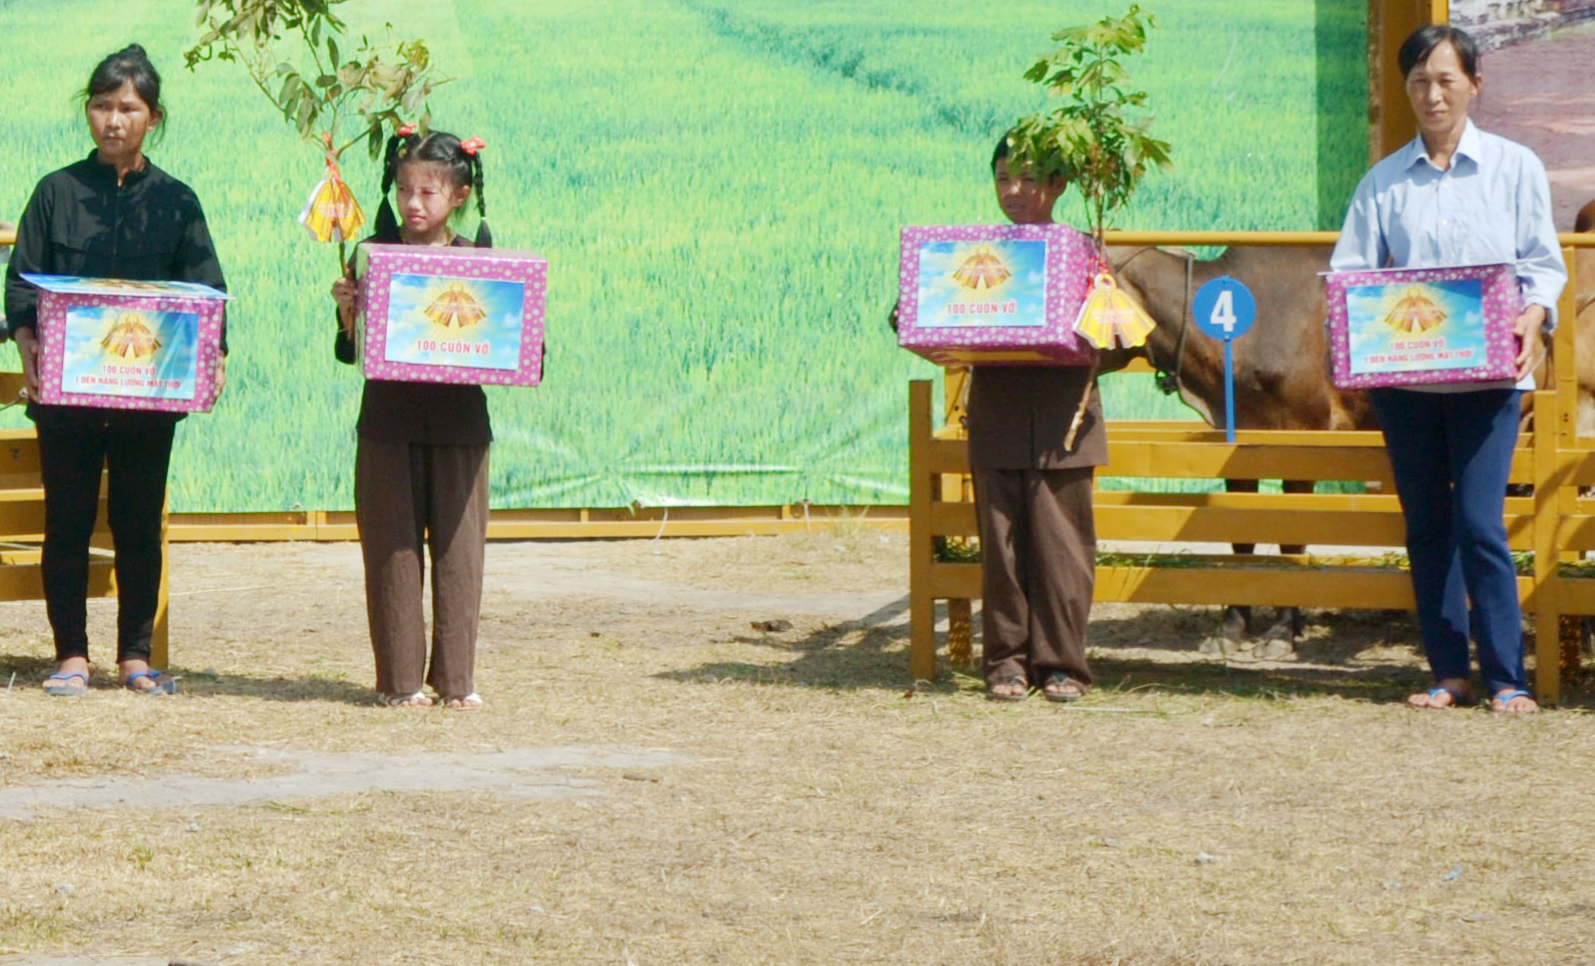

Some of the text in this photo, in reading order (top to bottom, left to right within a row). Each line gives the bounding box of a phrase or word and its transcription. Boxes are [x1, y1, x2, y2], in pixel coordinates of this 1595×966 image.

[948, 304, 965, 314] 100
[1210, 290, 1237, 332] 4
[417, 340, 436, 351] 100
[103, 365, 117, 373] 100
